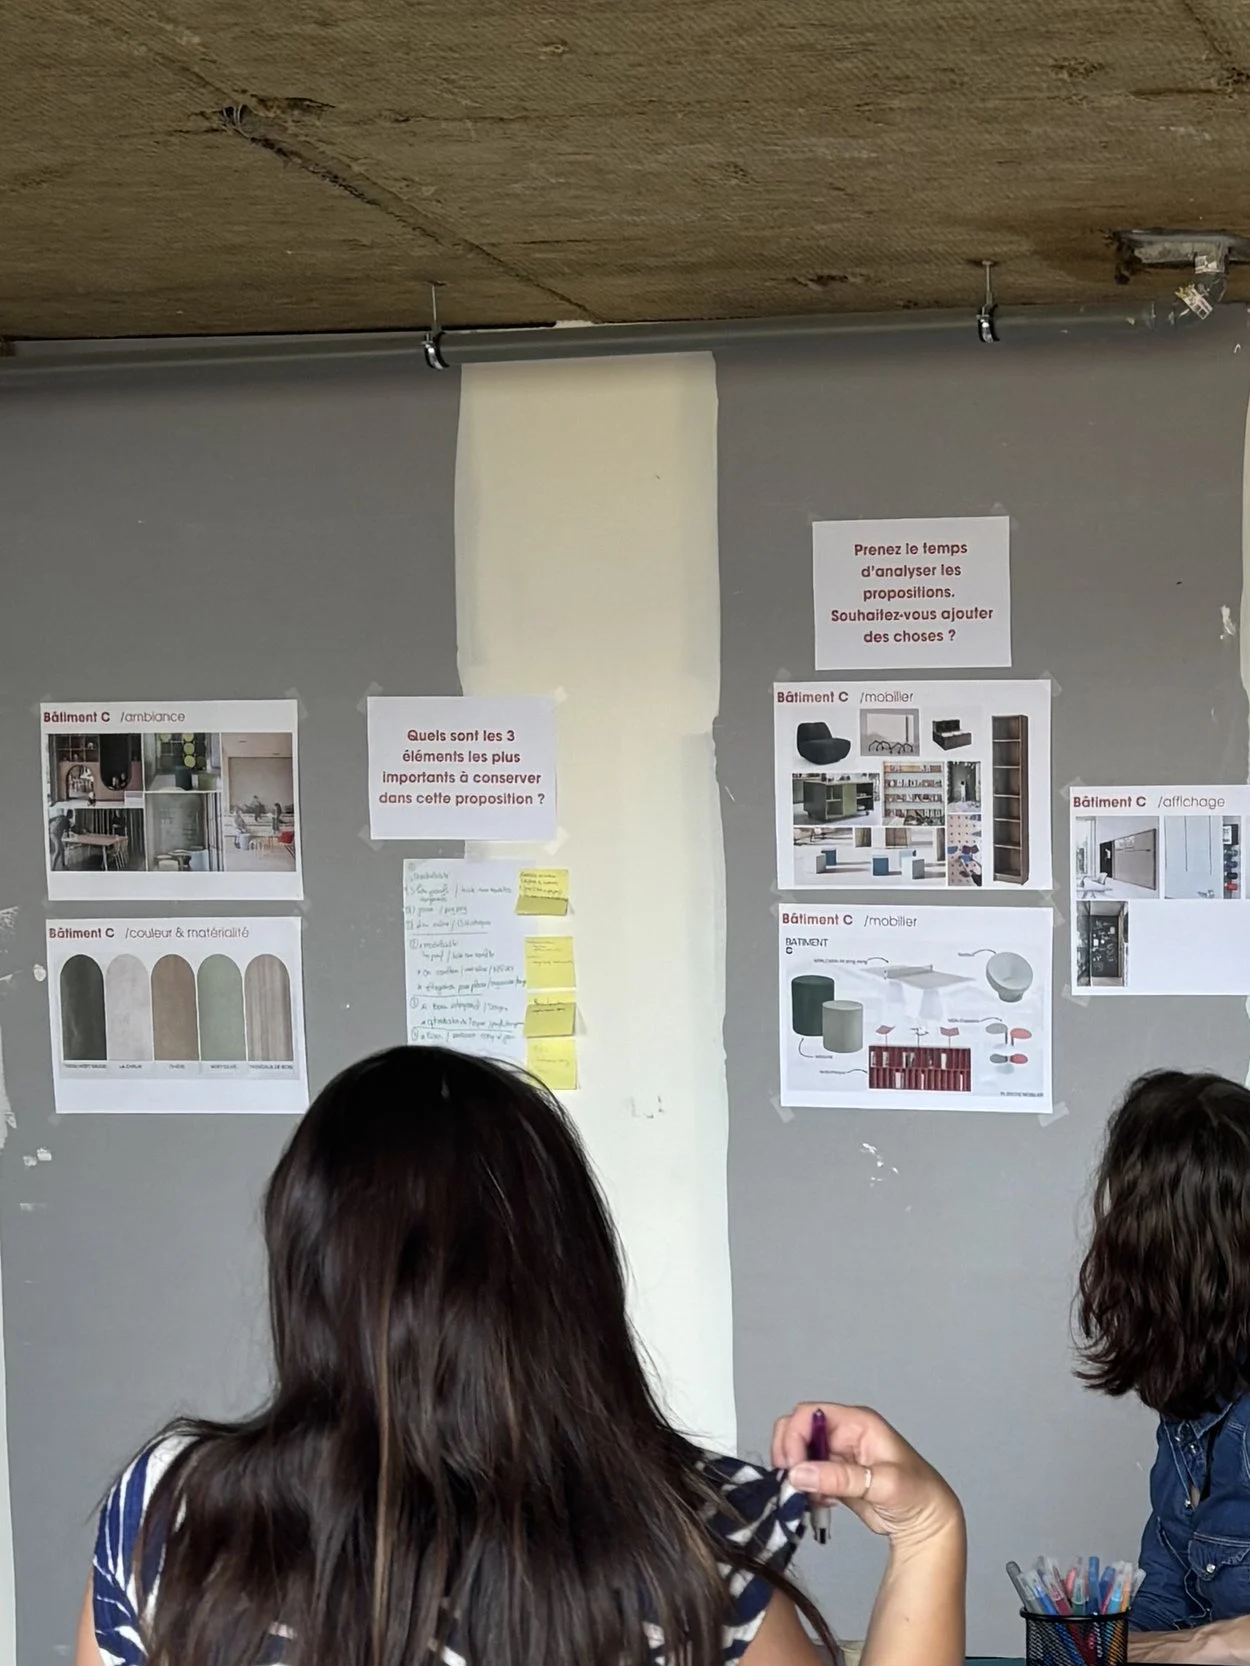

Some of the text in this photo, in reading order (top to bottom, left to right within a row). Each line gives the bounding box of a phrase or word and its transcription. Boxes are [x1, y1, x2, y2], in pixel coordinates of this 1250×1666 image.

[854, 541, 968, 557] Prenez le temps
[860, 563, 962, 580] d'analyser les
[862, 585, 956, 603] propositions.
[830, 606, 994, 624] Souhaitez-vous ajouter
[863, 628, 957, 644] des choses ?
[776, 690, 914, 705] Bâtiment C /mobilier
[43, 711, 186, 724] Bâtiment C /ambiance
[406, 729, 516, 743] Quels sont les 3
[402, 749, 521, 765] éléments les plus
[382, 770, 542, 786] importants à conserver
[378, 791, 546, 807] dans cette proposition ?
[1073, 795, 1226, 811] Bâtiment C /affichage
[781, 912, 918, 928] Bâtiment C /mobilier
[48, 926, 250, 940] Bâtiment C /couleur & matérialité
[785, 937, 829, 947] BATIMENT
[785, 946, 794, 955] C
